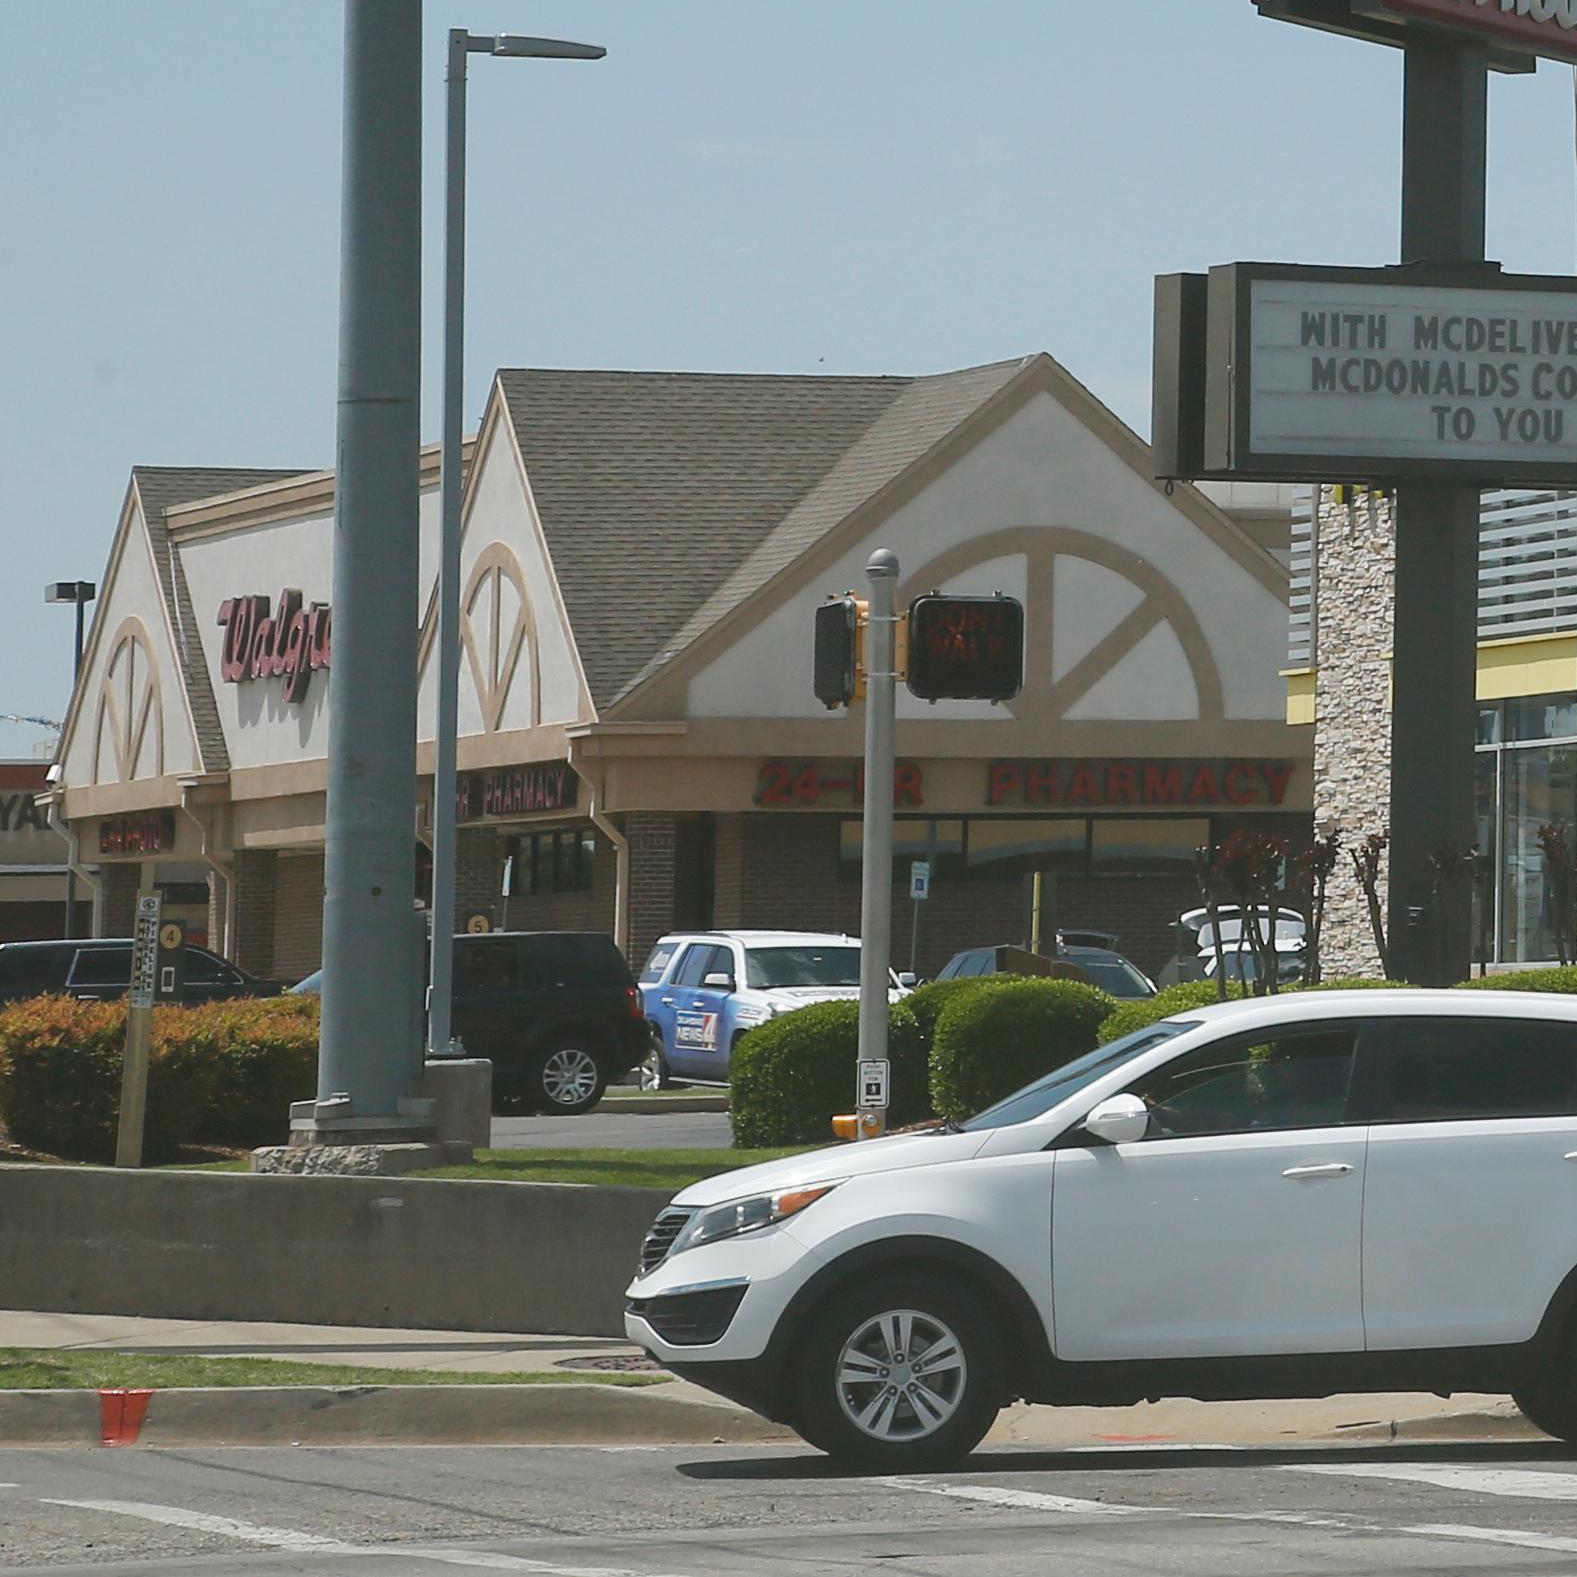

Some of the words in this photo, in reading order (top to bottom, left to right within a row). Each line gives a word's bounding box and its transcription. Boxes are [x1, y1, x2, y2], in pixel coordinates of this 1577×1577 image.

[1300, 311, 1387, 350] WITH
[1310, 357, 1520, 399] MCDONALDS
[1430, 405, 1475, 441] TO
[1494, 407, 1564, 445] YOU
[482, 770, 565, 817] PHARMACY
[987, 763, 1295, 806] PHARMACY
[165, 929, 177, 944] 4
